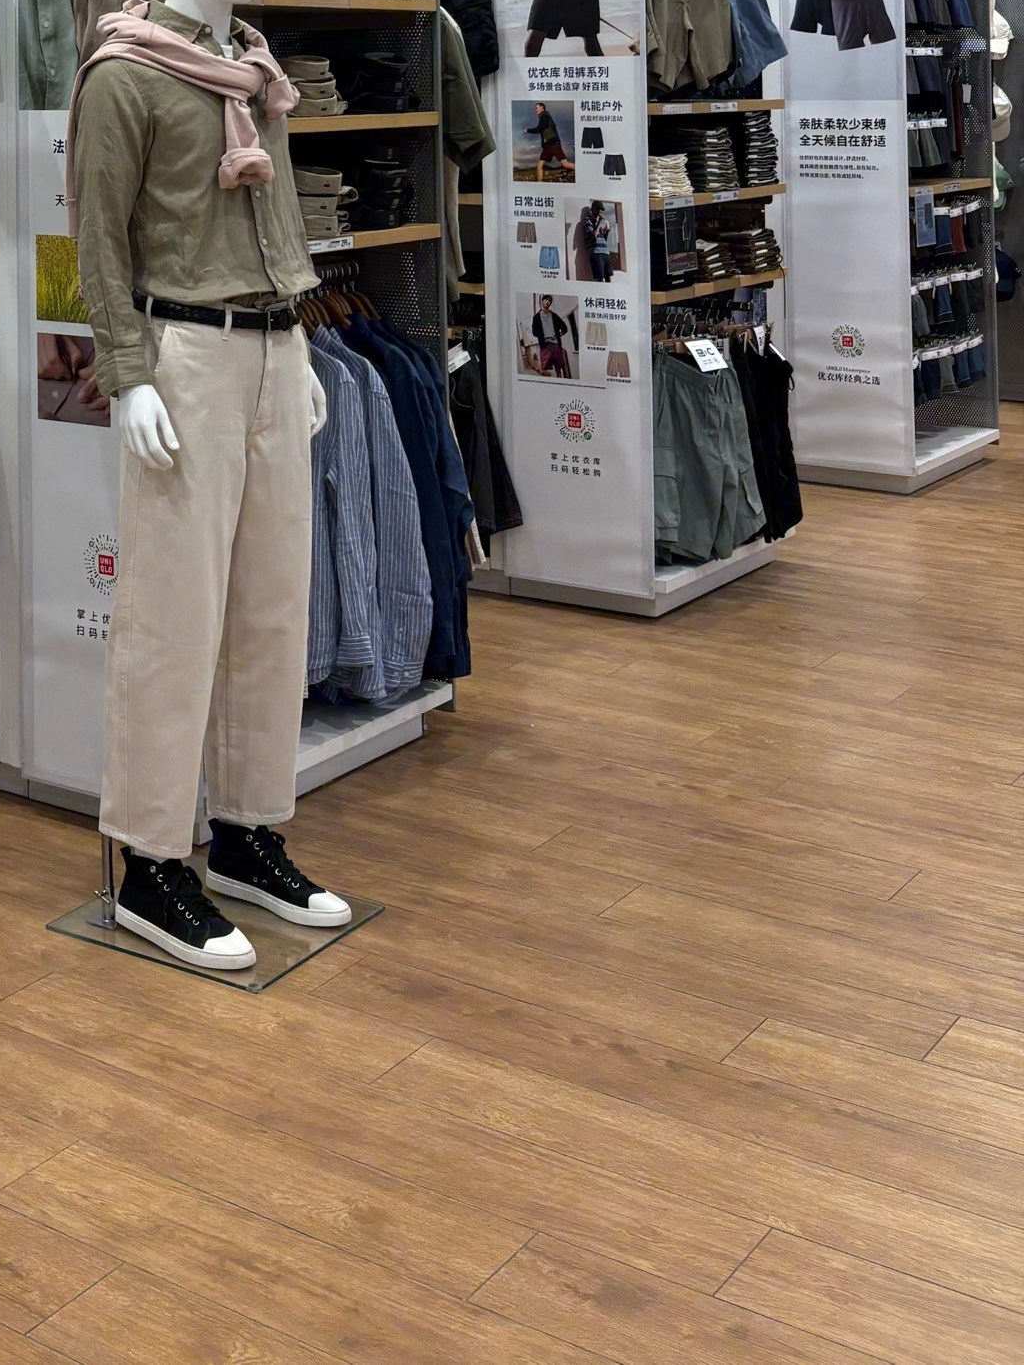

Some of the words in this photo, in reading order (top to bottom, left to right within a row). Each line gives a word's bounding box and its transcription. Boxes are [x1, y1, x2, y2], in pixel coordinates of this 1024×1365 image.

[527, 66, 561, 78] 优衣库
[563, 66, 609, 78] 短裤系列
[528, 81, 580, 92] 多场景合适穿
[582, 81, 609, 92] 好百搭
[580, 100, 623, 112] 机能户外
[798, 117, 887, 131] 亲肤柔软少束缚
[52, 139, 68, 154] 法
[799, 134, 887, 147] 全天候自在舒适
[55, 194, 69, 207] 天
[513, 196, 555, 208] 日常出街
[513, 209, 555, 219] 经典款式好搭配
[584, 297, 627, 310] 休闲轻松
[817, 371, 881, 386] 优衣库经典之选
[550, 452, 601, 466] 掌上优衣库
[550, 464, 601, 477] 扫码轻松购
[99, 556, 112, 566] UNI
[99, 564, 113, 574] QLO
